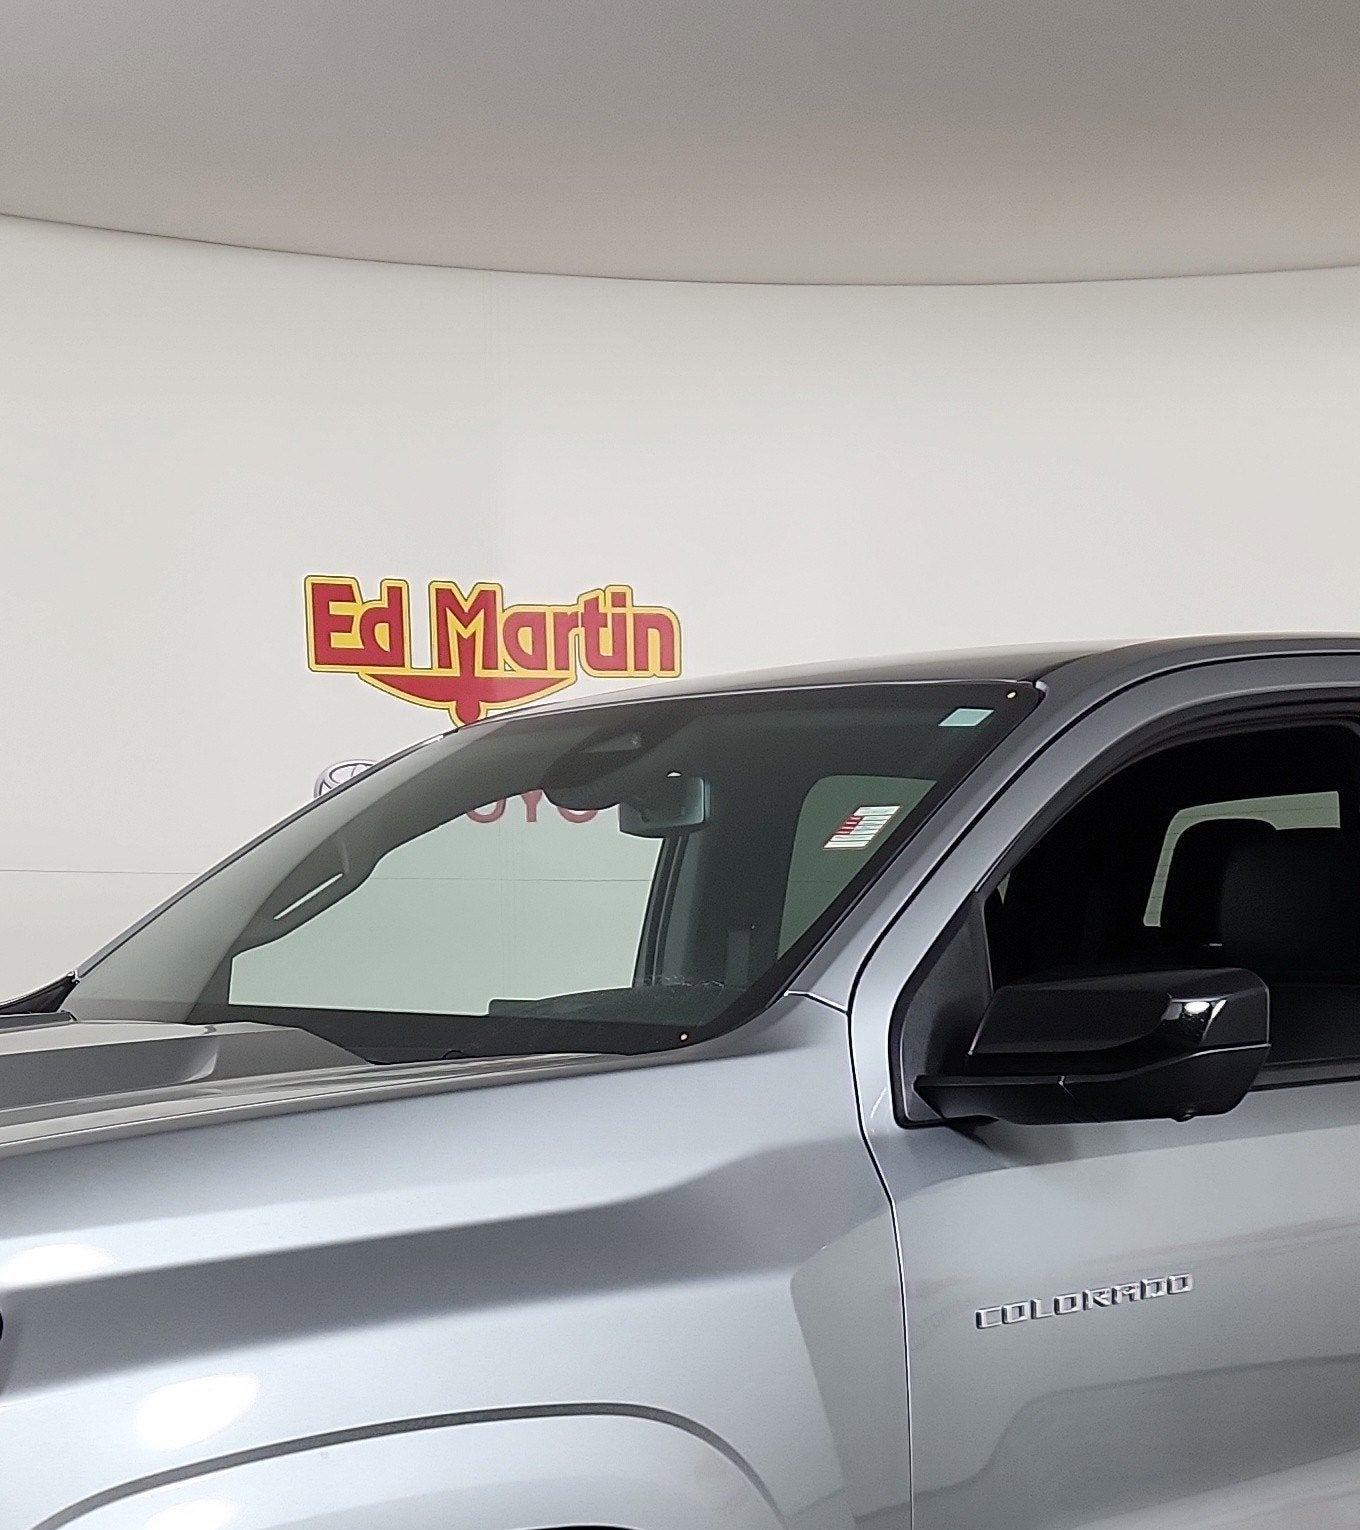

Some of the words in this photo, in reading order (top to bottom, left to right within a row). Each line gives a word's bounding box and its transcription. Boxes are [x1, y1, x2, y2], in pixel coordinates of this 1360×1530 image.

[306, 577, 408, 671] Ed
[431, 582, 680, 676] Martin
[975, 1273, 1194, 1329] COLORADO
